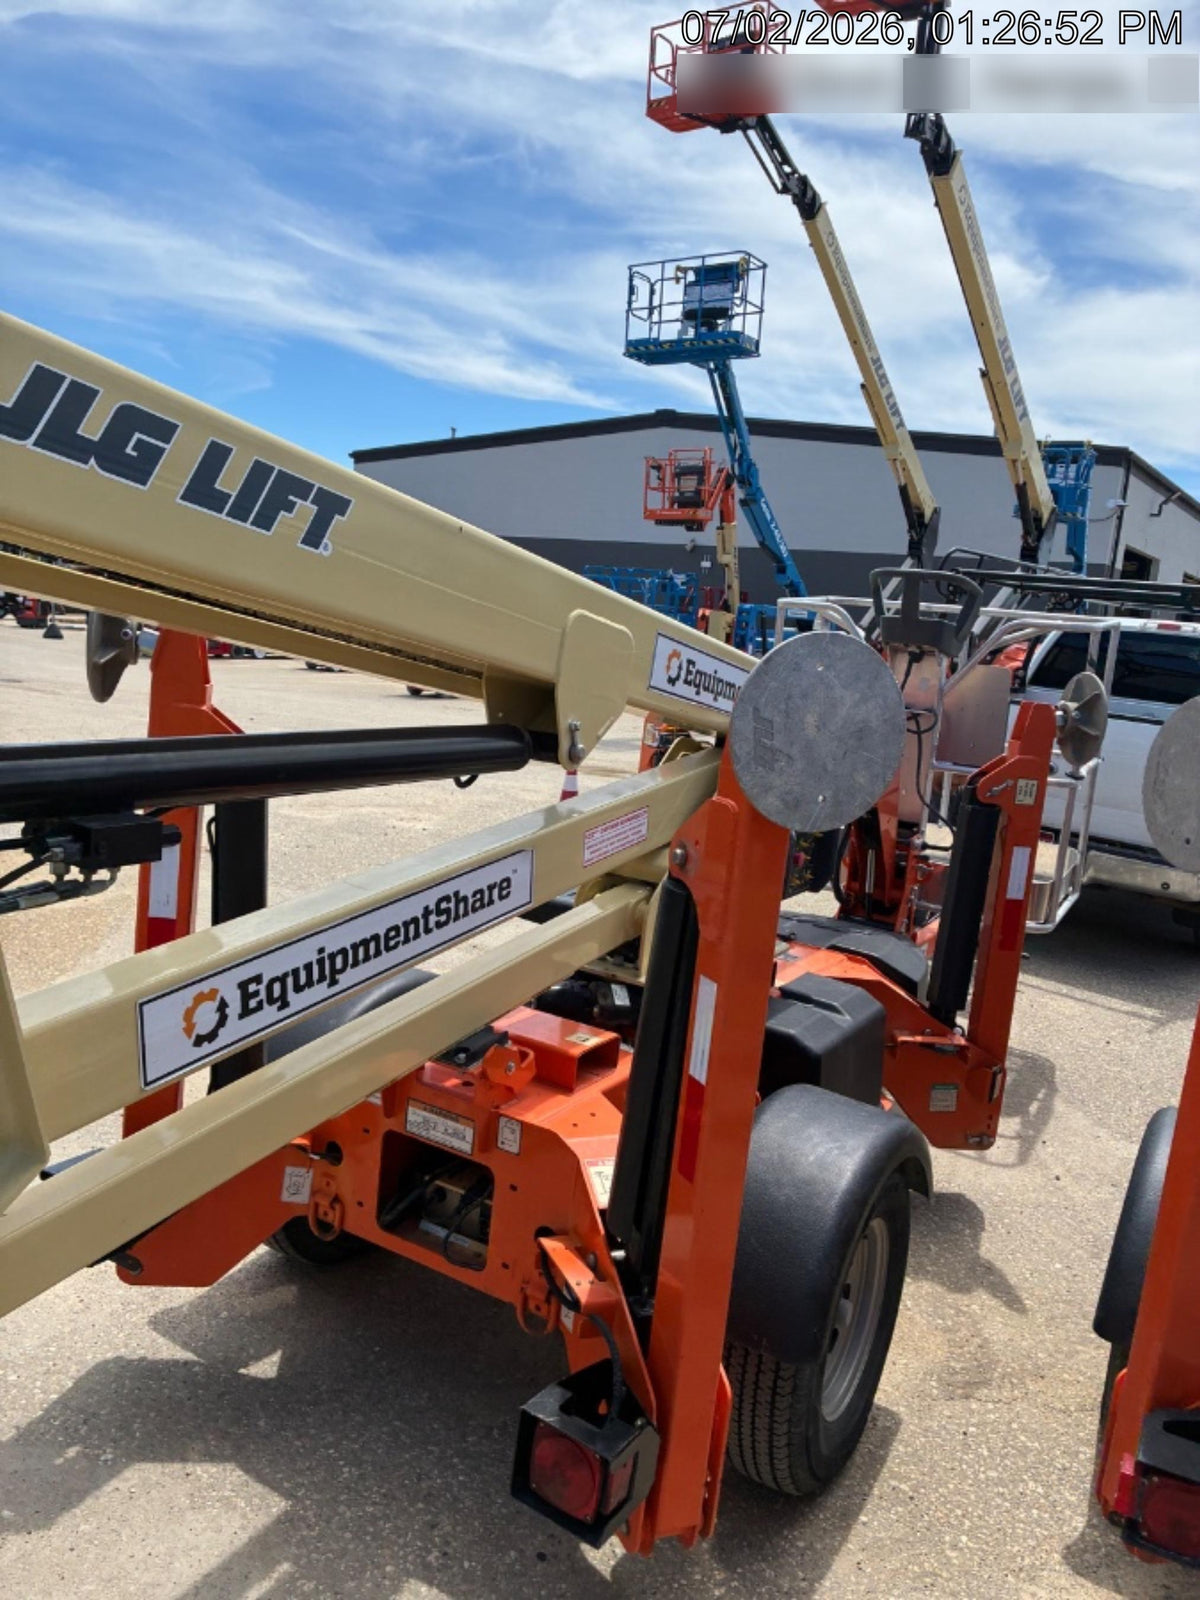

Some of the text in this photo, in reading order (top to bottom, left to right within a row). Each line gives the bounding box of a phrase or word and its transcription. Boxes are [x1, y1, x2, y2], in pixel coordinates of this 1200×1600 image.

[870, 354, 906, 430] JLG LIFT
[997, 335, 1029, 422] JLG LIFT
[0, 360, 354, 552] JLG LIFT
[237, 875, 512, 1020] EquipmentShare
